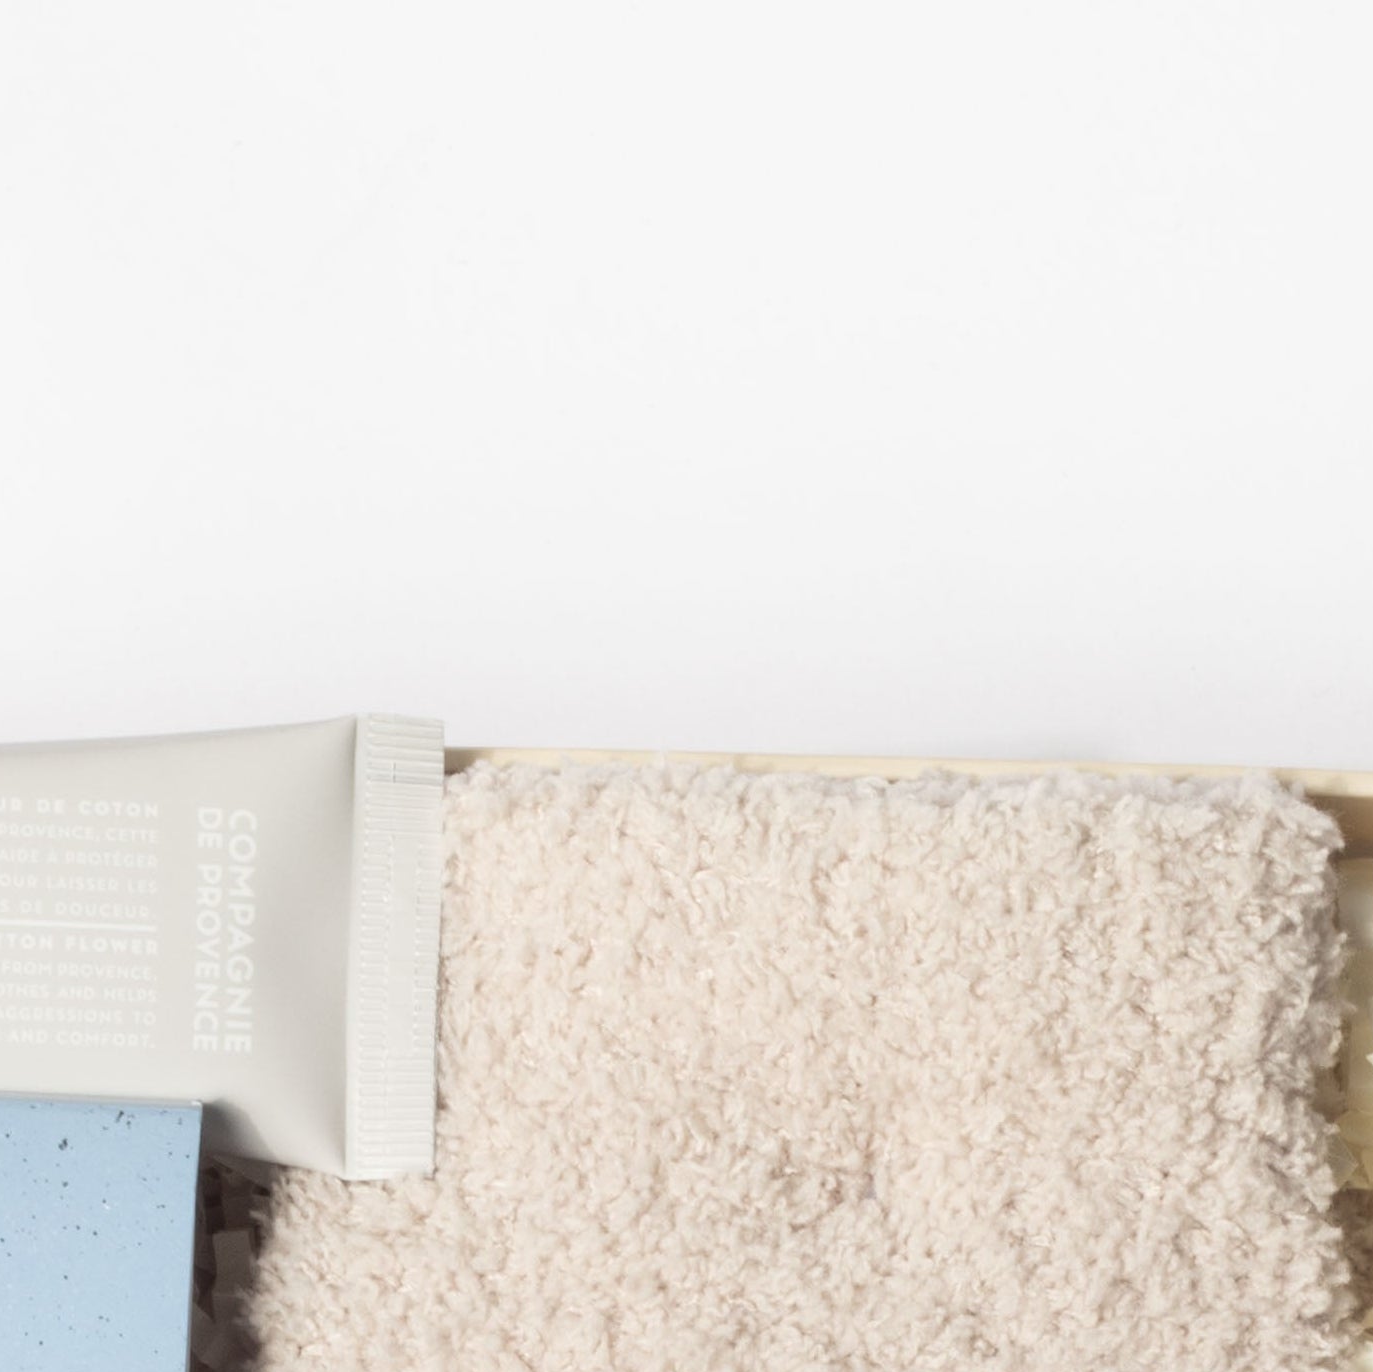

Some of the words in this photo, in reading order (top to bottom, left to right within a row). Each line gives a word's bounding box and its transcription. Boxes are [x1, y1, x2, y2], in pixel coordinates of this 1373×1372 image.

[37, 799, 66, 814] DE
[79, 800, 158, 818] COTON
[197, 807, 223, 849] DE
[66, 936, 159, 956] FLOWER
[224, 809, 257, 1053] COMPAGNIE
[192, 864, 223, 1052] PROVENCE
